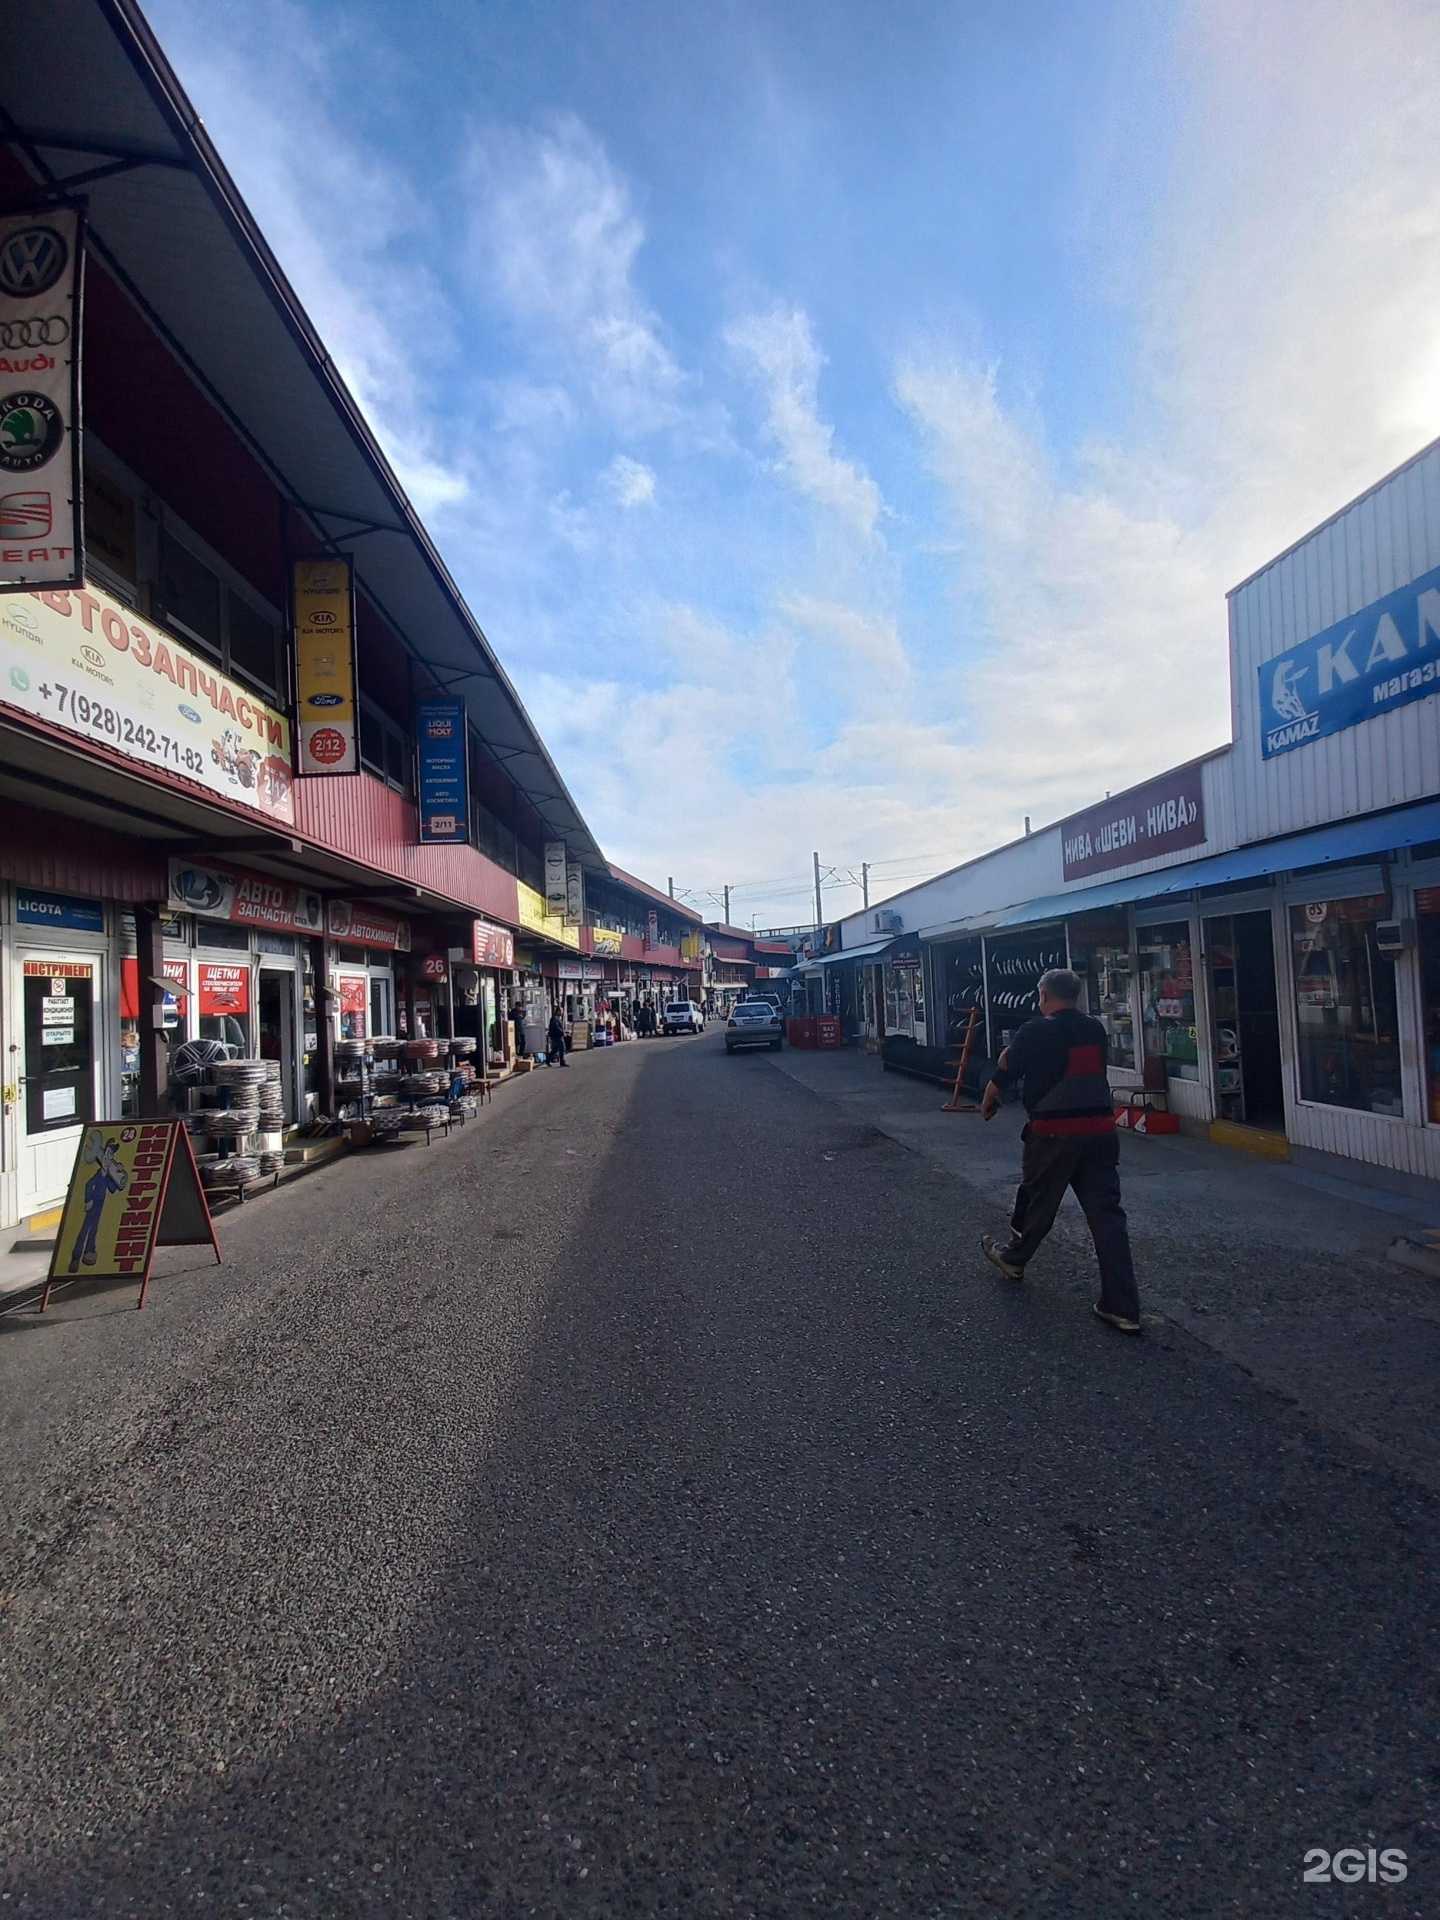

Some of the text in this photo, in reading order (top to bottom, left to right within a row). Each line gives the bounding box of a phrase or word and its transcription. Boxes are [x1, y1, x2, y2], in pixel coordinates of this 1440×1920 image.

[0, 395, 55, 425] KODA
[2, 546, 73, 562] EAT
[2, 617, 44, 646] HYUNDAI
[314, 614, 332, 622] KIA
[30, 588, 283, 749] ВТОЗАПЧАСТИ
[84, 647, 102, 665] KIA
[72, 657, 115, 687] KIA MOTORS
[1373, 659, 1440, 703] магаз
[38, 682, 204, 774] +7(928)242-71-82
[1267, 716, 1321, 752] KAMAZ
[1064, 832, 1093, 865] НИВА
[1094, 815, 1137, 854] «ШЕВИ
[1147, 795, 1197, 838] НИВА»
[18, 899, 62, 916] LICOTA
[238, 879, 283, 908] АВТО
[238, 902, 292, 924] ЗАПЧАСТИ
[351, 923, 396, 944] АВТОХИМИЯ
[23, 962, 91, 977] ИНСТРУМЕНТ
[207, 967, 240, 981] ЩЕТКИ
[426, 960, 444, 974] 26
[113, 1126, 170, 1272] ИНСТРУМЕНТ
